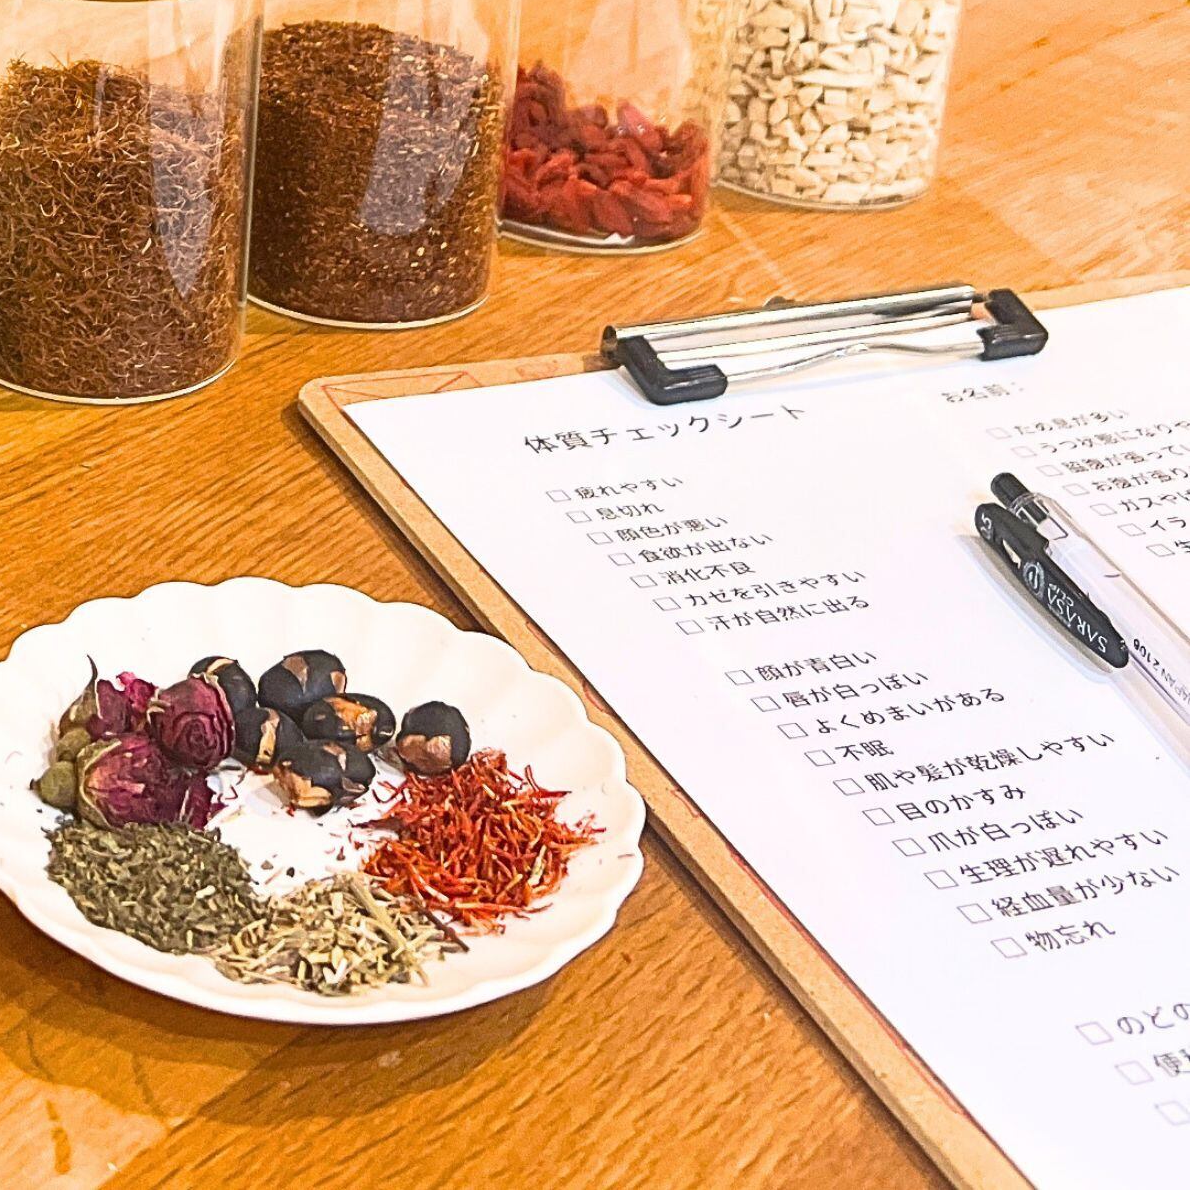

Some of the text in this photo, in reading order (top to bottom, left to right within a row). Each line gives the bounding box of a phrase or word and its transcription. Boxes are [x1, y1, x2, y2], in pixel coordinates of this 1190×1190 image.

[524, 405, 805, 454] 体質チェックシート
[574, 477, 683, 500] 疲れやすい
[596, 503, 665, 521] 息切れ
[615, 516, 728, 542] 顔色が悪い
[638, 534, 774, 564] 食欲が出ない
[661, 561, 756, 585] 消化不良
[685, 571, 866, 607] カゼを引きやすい
[708, 596, 869, 631] 汗が自然に出る
[1047, 587, 1108, 654] SARASA
[755, 652, 877, 681] 顔が青白い
[782, 672, 928, 708] 唇が白っぽい
[816, 688, 1005, 734] よくめまいがある
[835, 739, 894, 761] 不眠
[864, 733, 1114, 791] 肌や髪が乾燥しやすい
[896, 784, 1026, 821] 目のかすみ
[928, 809, 1083, 852] 爪が白っぽい
[960, 830, 1168, 884] 生理が遅れやすい
[991, 866, 1180, 917] 経血量が少ない
[1025, 920, 1116, 952] 物忘れ
